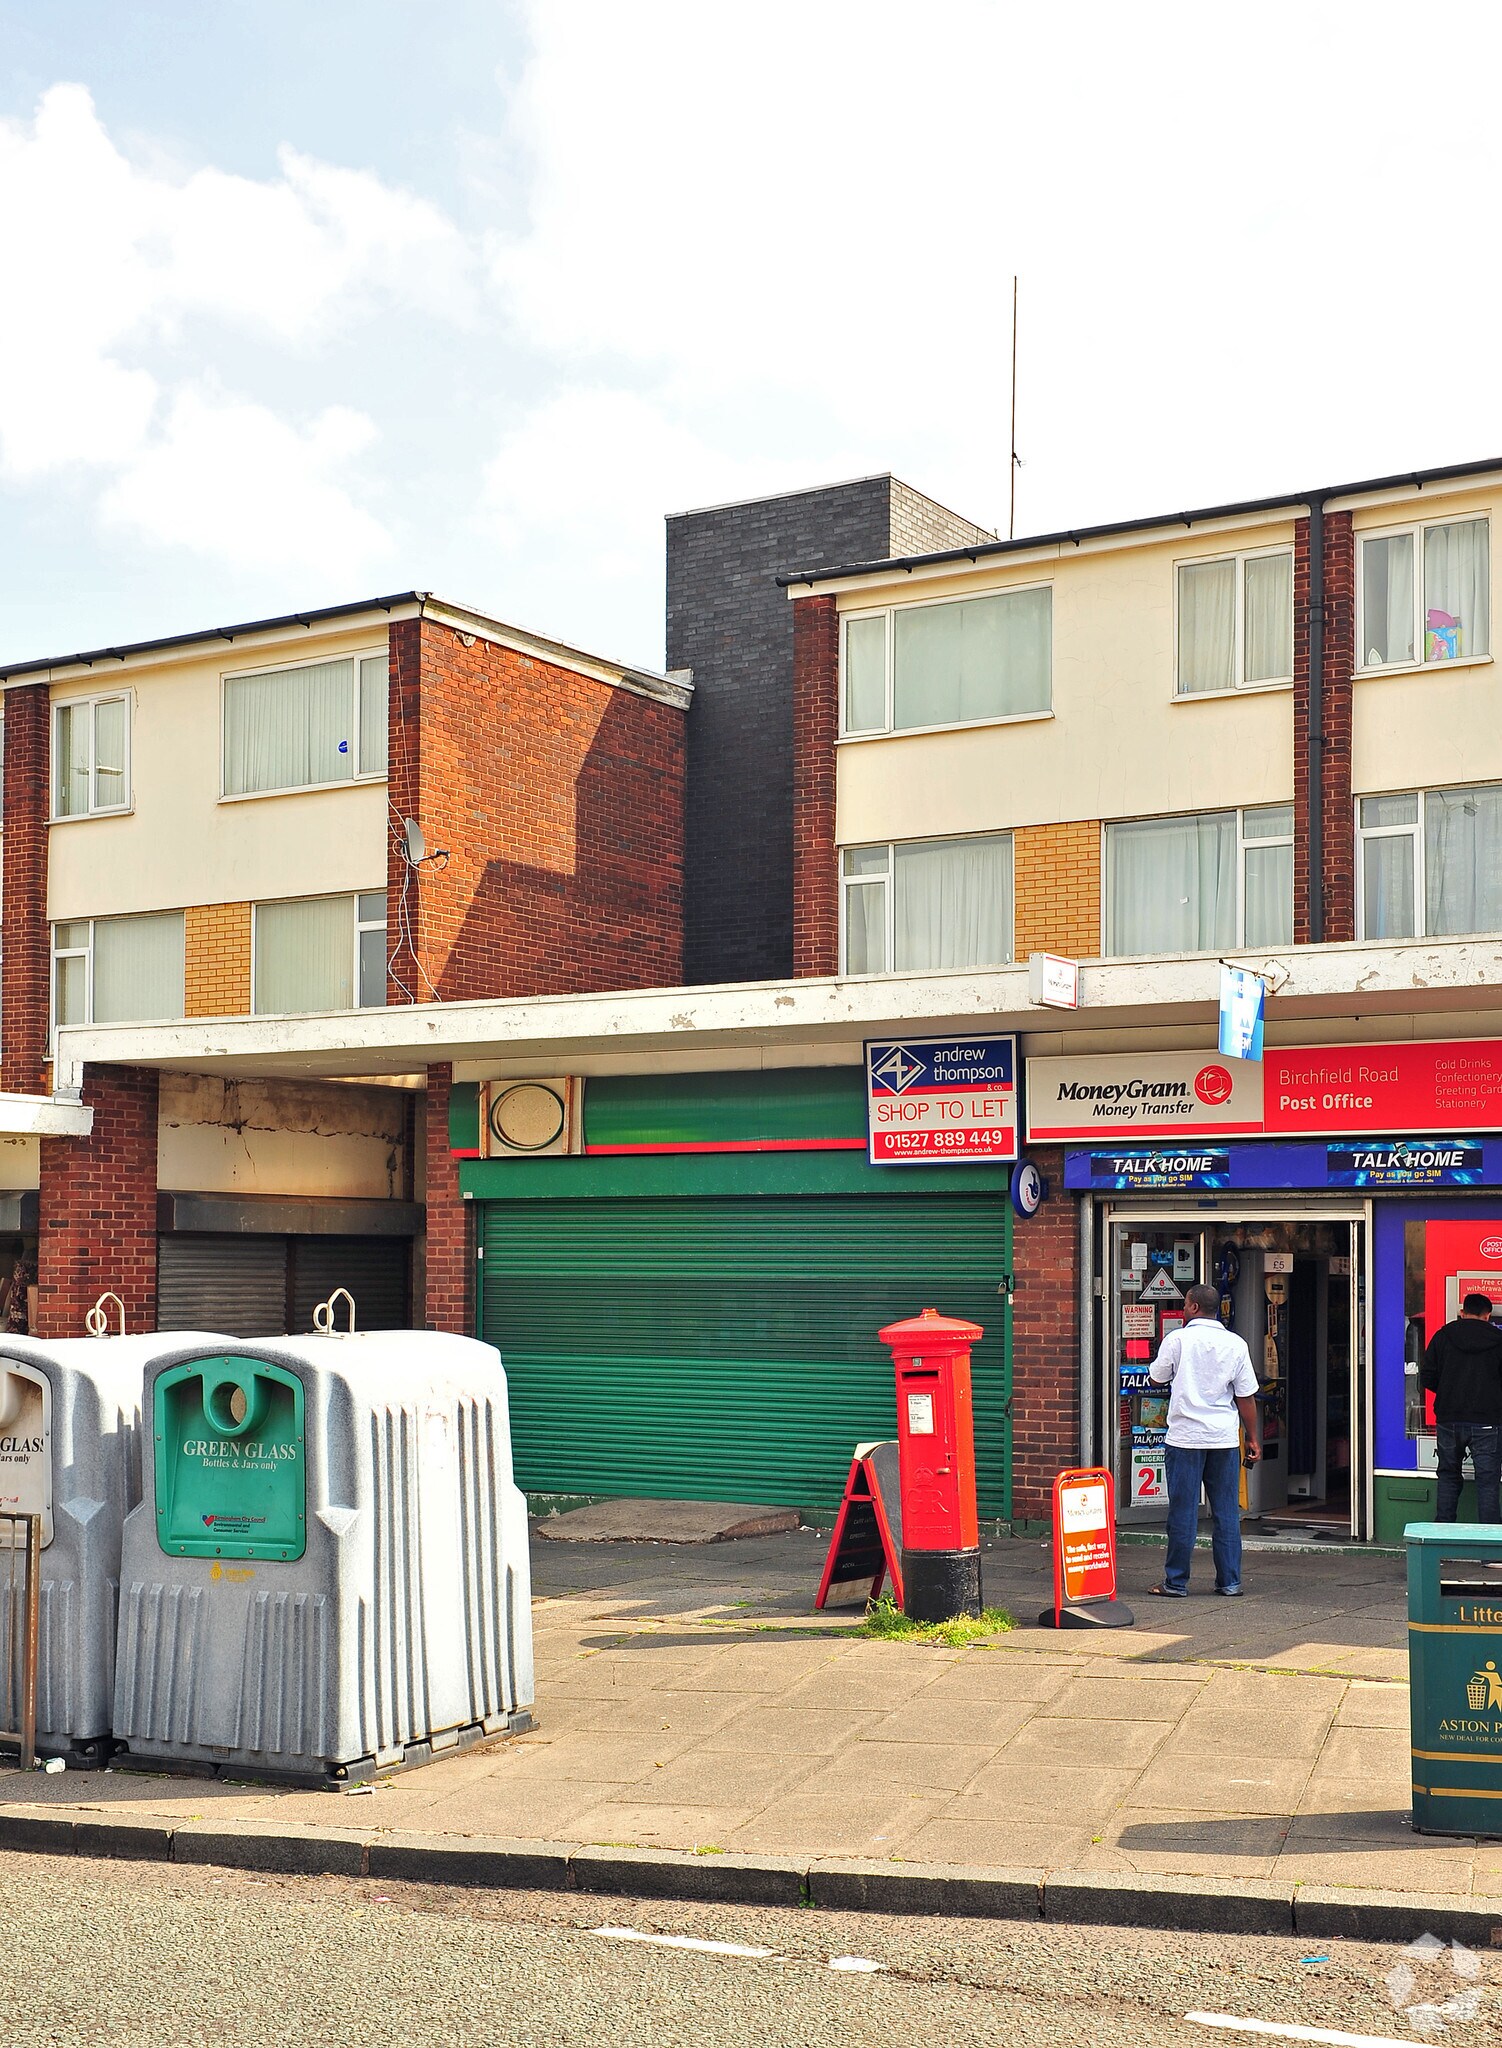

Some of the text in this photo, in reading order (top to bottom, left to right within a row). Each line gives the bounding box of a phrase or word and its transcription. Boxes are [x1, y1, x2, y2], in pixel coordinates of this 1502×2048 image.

[934, 1046, 985, 1062] andrew
[1435, 1058, 1491, 1070] Cold Drinks
[934, 1066, 1004, 1083] thompson
[1279, 1066, 1399, 1085] Birchfield Road
[1435, 1071, 1502, 1083] Confectionery
[1435, 1086, 1476, 1097] Greeting
[1280, 1093, 1373, 1110] Post Office
[1435, 1099, 1486, 1109] Stationery
[877, 1099, 1009, 1122] SHOP TO LET
[1093, 1100, 1194, 1119] Money Transfer
[884, 1130, 1003, 1148] 01527 889 449
[894, 1146, 992, 1156] www.andrew-thompson.co.uk
[1113, 1157, 1212, 1172] TALK HOME
[1352, 1151, 1464, 1168] TALK HOME
[1370, 1170, 1384, 1179] Pay
[1273, 1261, 1284, 1270] £5
[1122, 1375, 1150, 1387] TALK
[183, 1440, 296, 1460] GREEN GLASS
[14, 1454, 30, 1464] only
[202, 1458, 229, 1468] Bottles
[241, 1460, 258, 1469] Jars
[261, 1461, 278, 1472] only
[1093, 1551, 1109, 1559] receive
[1085, 1560, 1109, 1570] worldwide
[1439, 1719, 1489, 1732] ASTON
